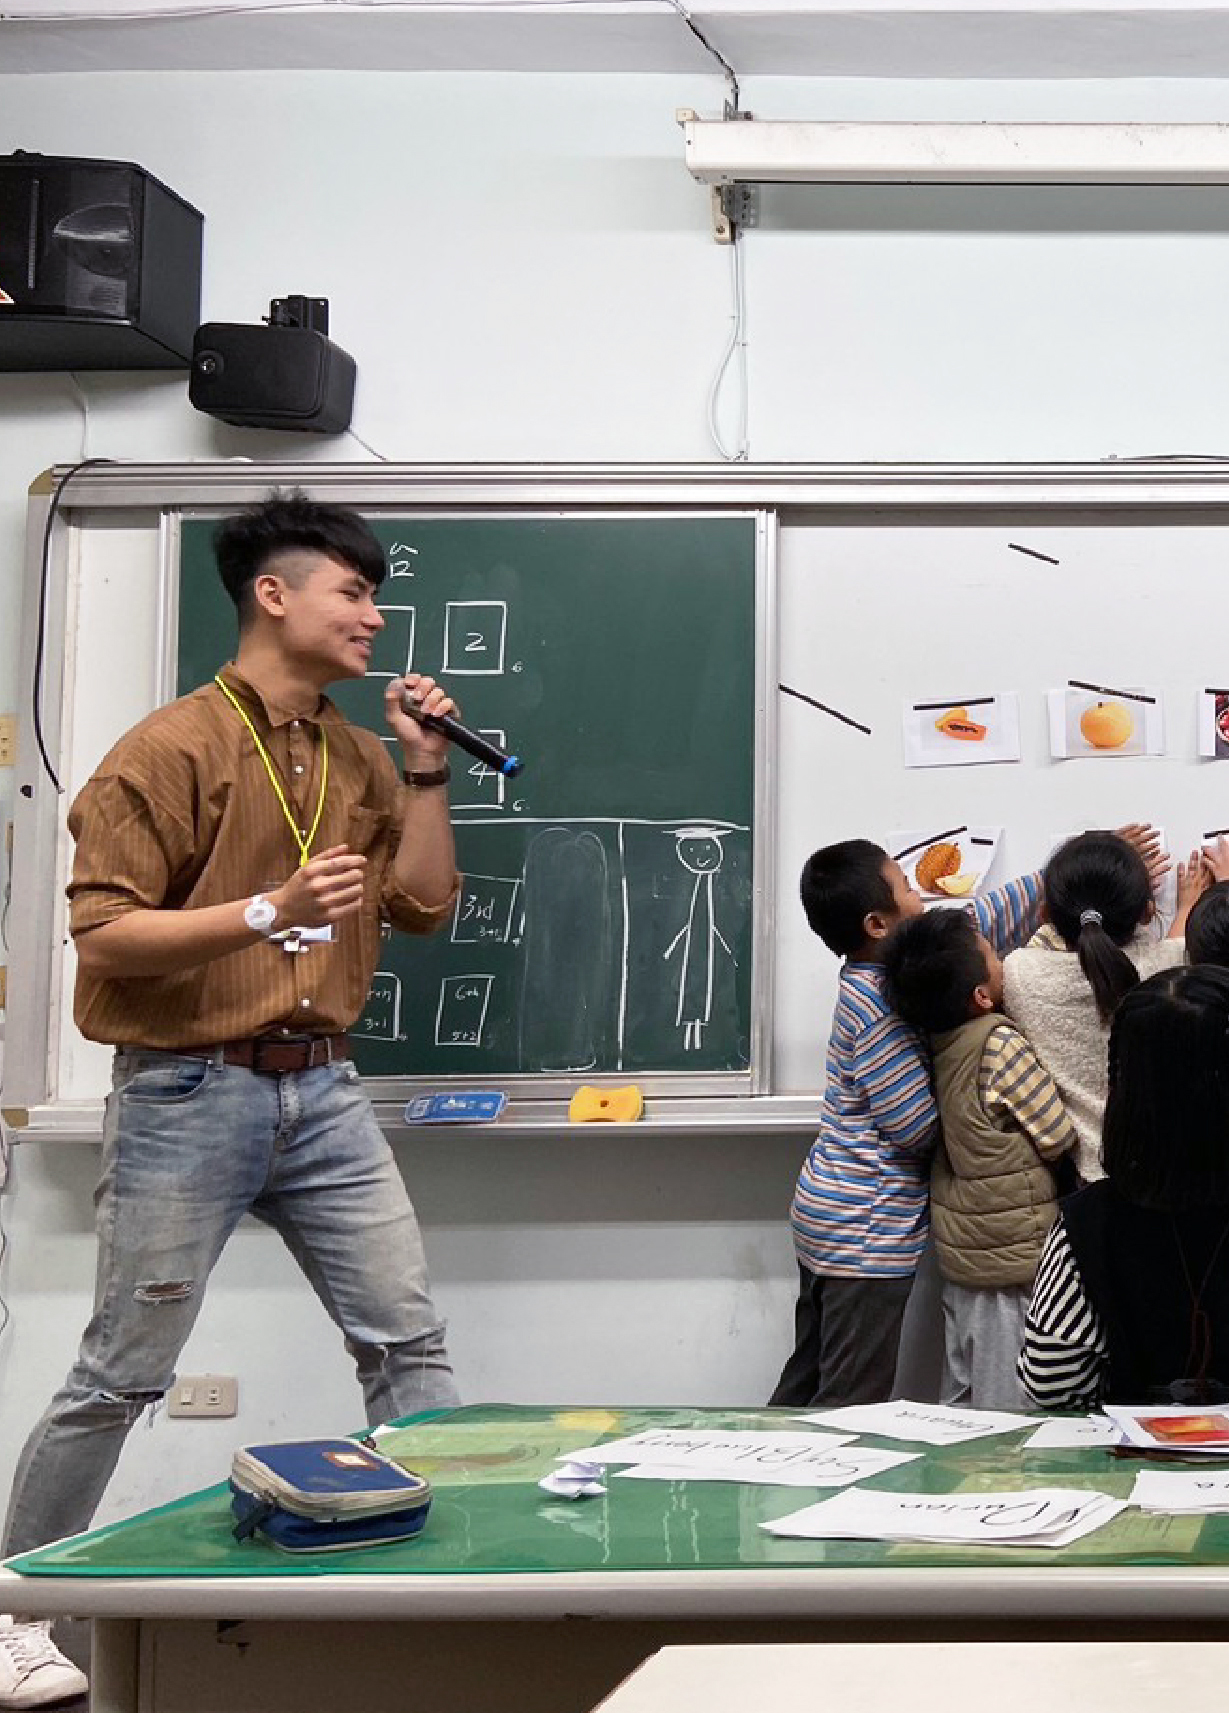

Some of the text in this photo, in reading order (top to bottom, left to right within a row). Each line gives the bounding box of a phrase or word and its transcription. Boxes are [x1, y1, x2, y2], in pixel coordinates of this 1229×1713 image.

[465, 632, 487, 652] 2
[467, 760, 497, 786] 4
[898, 1500, 1051, 1526] Durian
